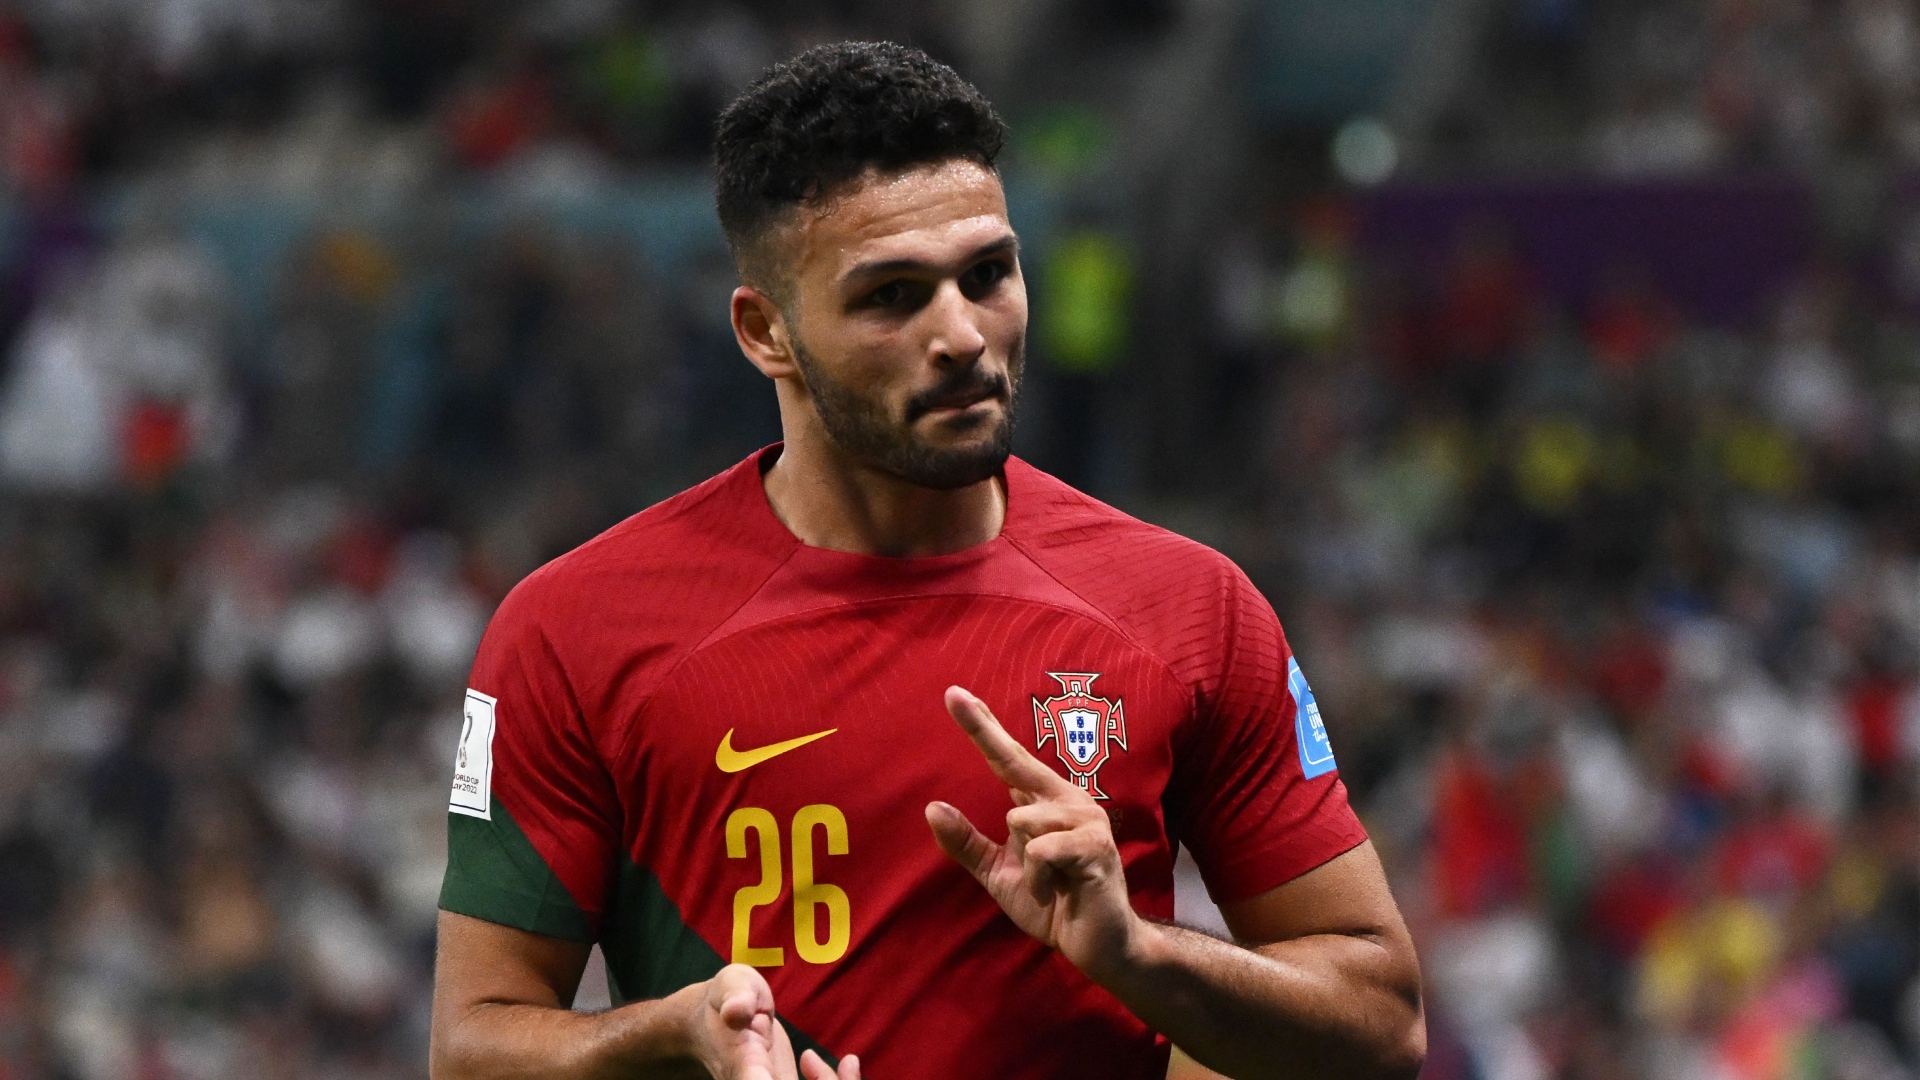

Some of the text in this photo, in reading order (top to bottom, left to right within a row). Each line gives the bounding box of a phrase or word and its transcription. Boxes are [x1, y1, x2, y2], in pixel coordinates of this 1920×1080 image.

[455, 774, 479, 785] ORLD CUP
[725, 804, 850, 967] 26
